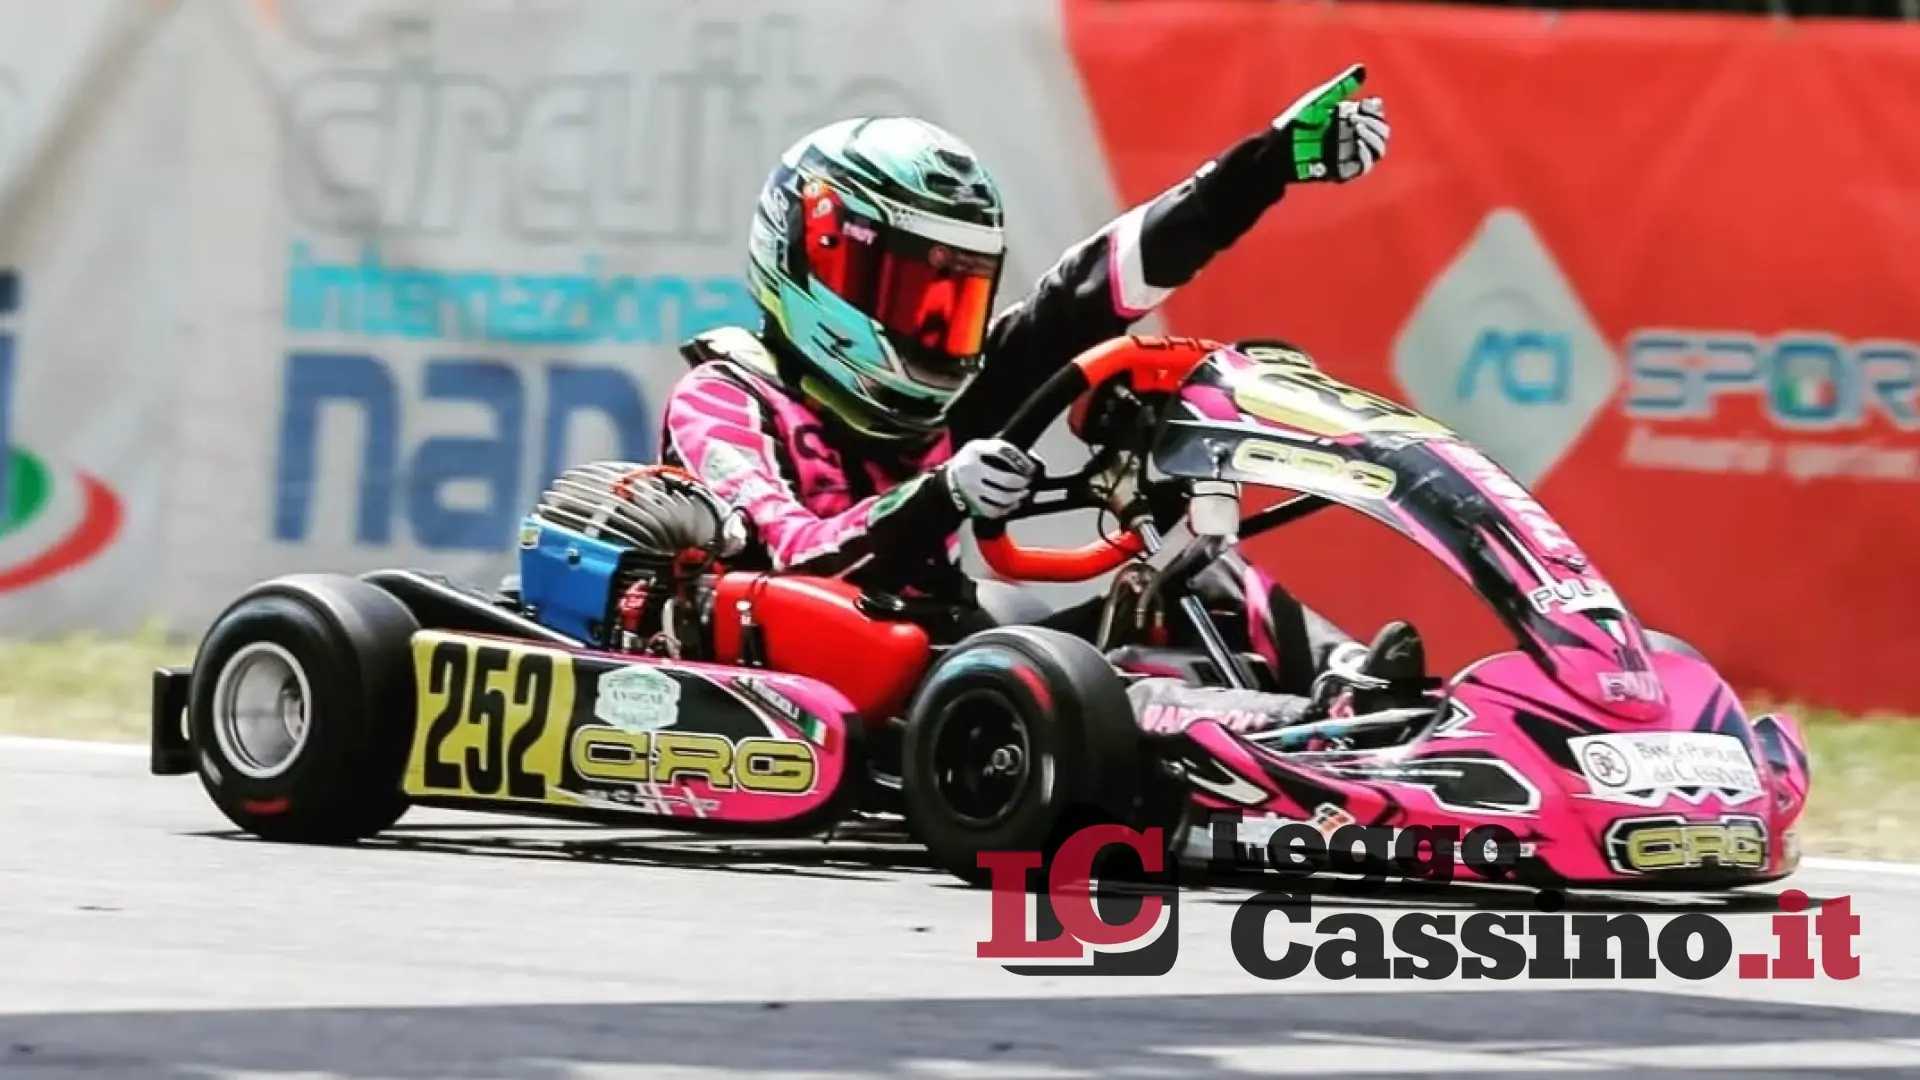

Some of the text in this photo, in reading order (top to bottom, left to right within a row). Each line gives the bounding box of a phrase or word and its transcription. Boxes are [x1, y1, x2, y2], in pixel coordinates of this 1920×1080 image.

[1232, 438, 1397, 500] CRG
[423, 641, 555, 799] 252
[570, 723, 820, 796] CRG
[1626, 825, 1767, 872] CRG
